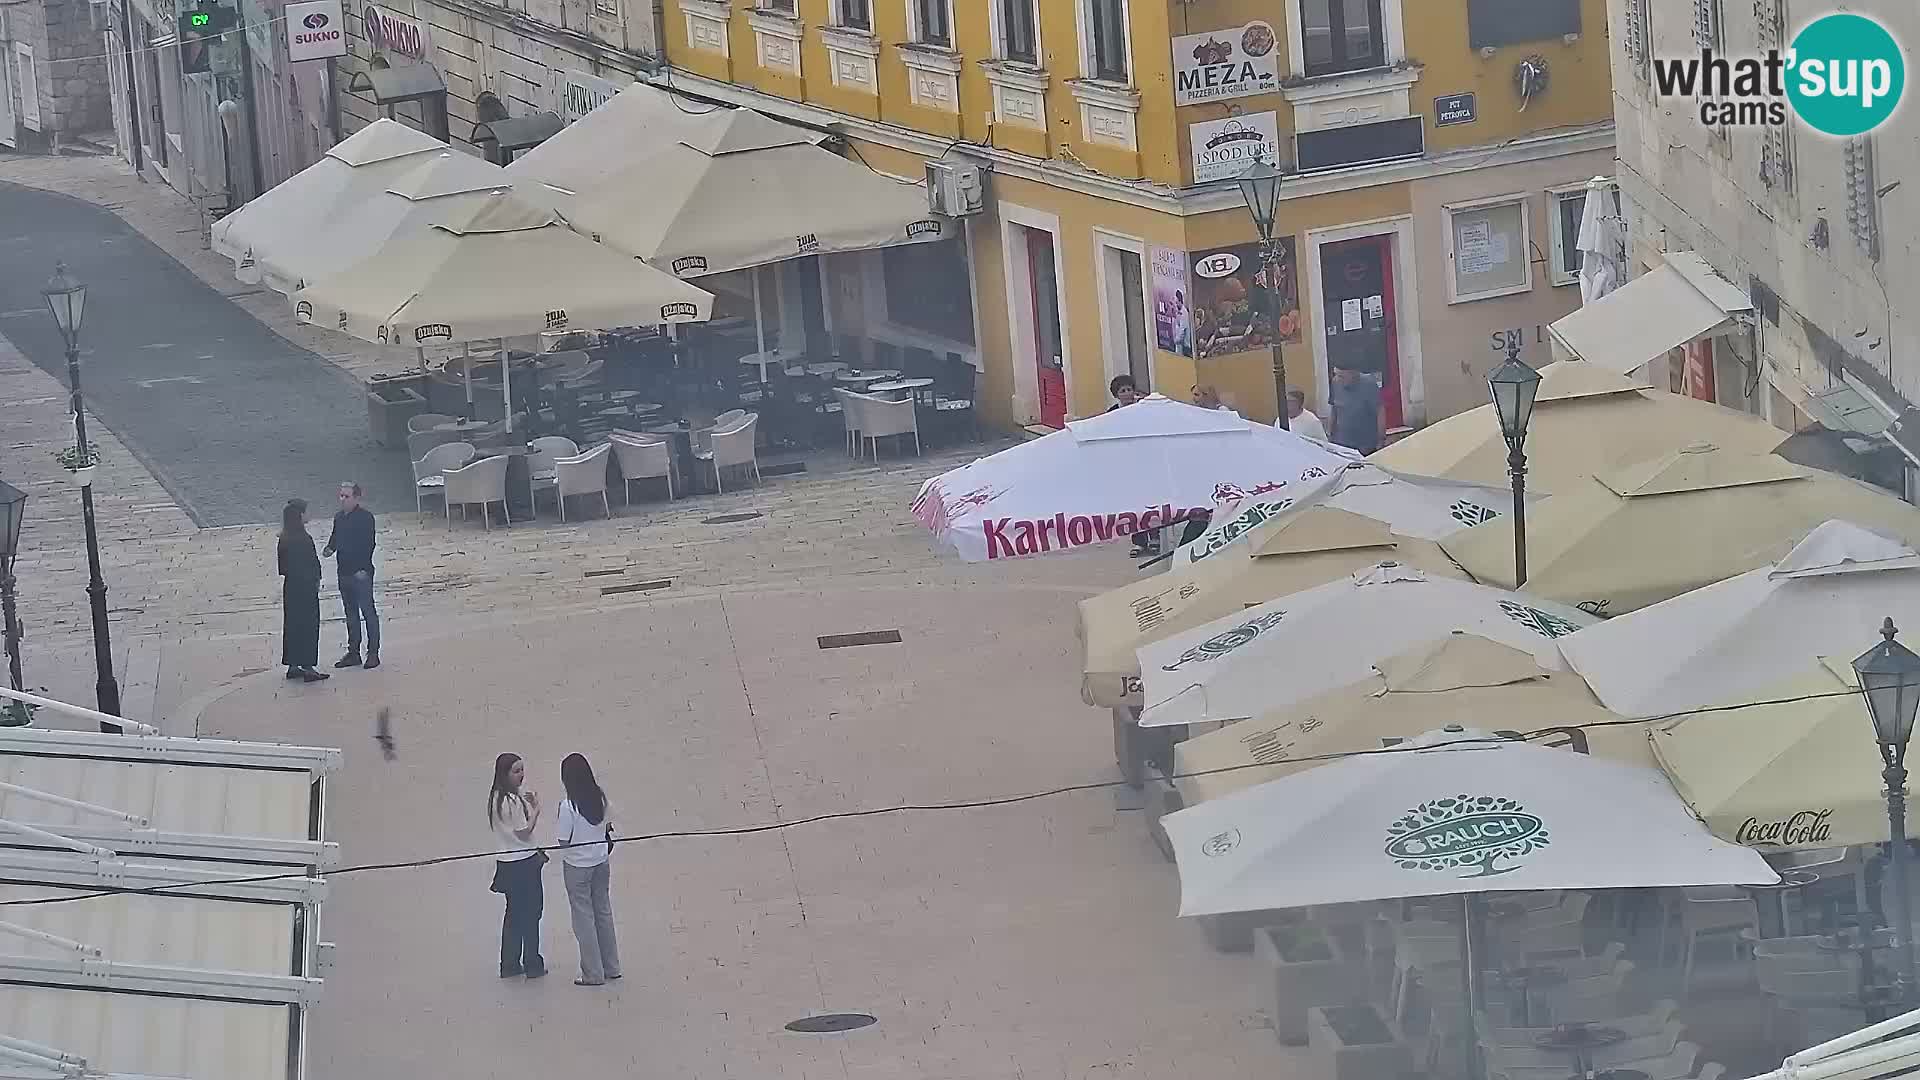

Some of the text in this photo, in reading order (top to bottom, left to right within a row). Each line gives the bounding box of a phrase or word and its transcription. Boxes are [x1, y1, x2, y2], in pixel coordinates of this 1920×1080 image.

[296, 30, 340, 44] SUKNO
[382, 15, 421, 54] SUKNO
[1178, 61, 1257, 92] MEZA
[1188, 83, 1249, 99] PIZZERIA & GRILL
[1197, 147, 1242, 165] ISPOD
[1425, 818, 1524, 849] RAUCH
[1736, 809, 1833, 846] Coca-Cola
